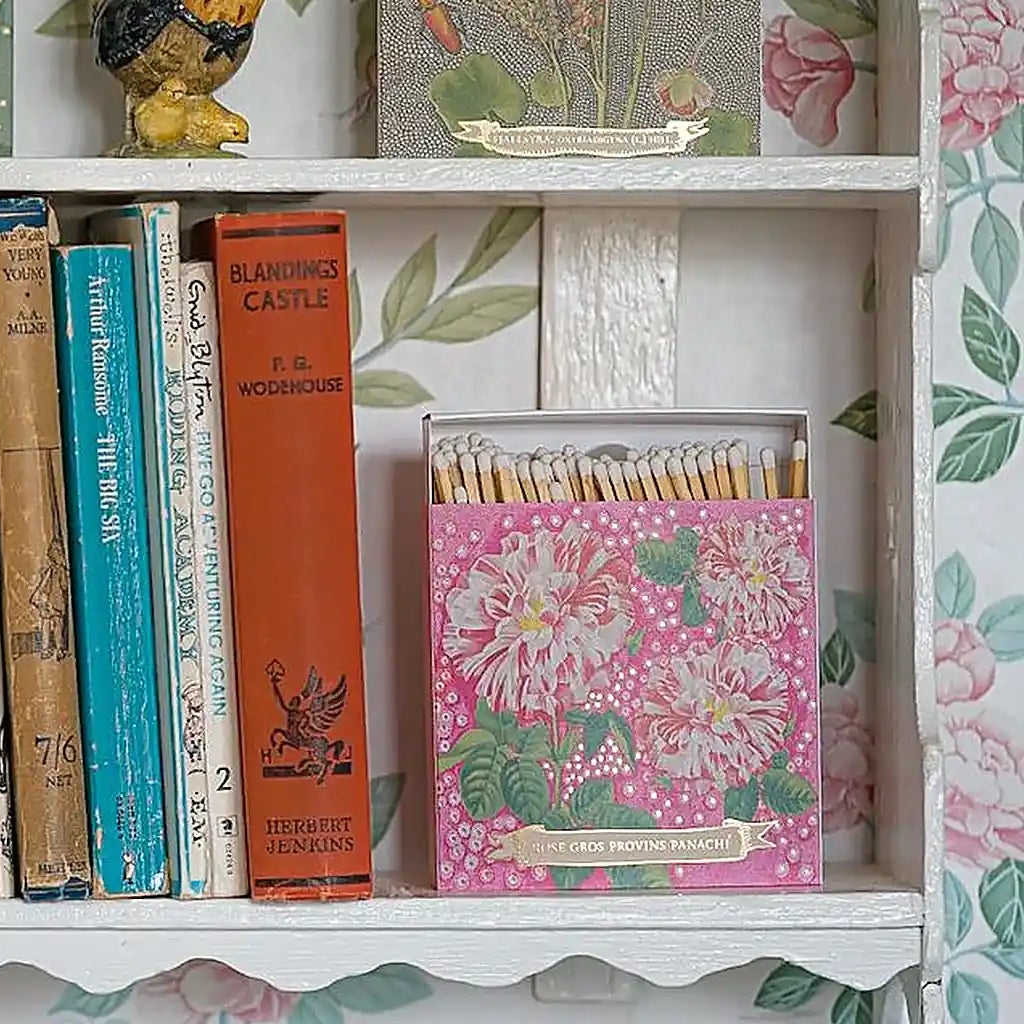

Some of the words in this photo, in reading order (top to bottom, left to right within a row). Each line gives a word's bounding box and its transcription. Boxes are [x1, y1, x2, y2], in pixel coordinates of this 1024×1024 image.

[8, 247, 43, 261] VERY
[3, 268, 46, 282] YOUNG
[230, 259, 339, 284] BLANDINGS
[87, 276, 109, 336] Arthur
[188, 279, 206, 333] Enid
[243, 288, 329, 312] CASTLE
[8, 322, 47, 335] MILNE
[91, 338, 110, 417] Ransome
[273, 357, 286, 372] P.
[294, 356, 313, 370] G.
[185, 343, 212, 421] Blyton
[238, 377, 344, 397] WODEHOUSE
[164, 366, 188, 495] RIDING
[96, 432, 117, 474] THE
[196, 431, 214, 470] FIVE
[98, 479, 119, 509] BIG
[199, 475, 215, 507] GO
[100, 514, 121, 544] SIX
[172, 506, 200, 667] ACADEMY
[208, 654, 227, 716] AGAIN
[35, 733, 77, 771] 7/6
[45, 775, 72, 788] NET
[215, 767, 232, 791] 2
[266, 817, 353, 836] HERBERT
[266, 836, 355, 855] JENKINS
[570, 840, 605, 854] GROS
[609, 839, 671, 853] PROVINS
